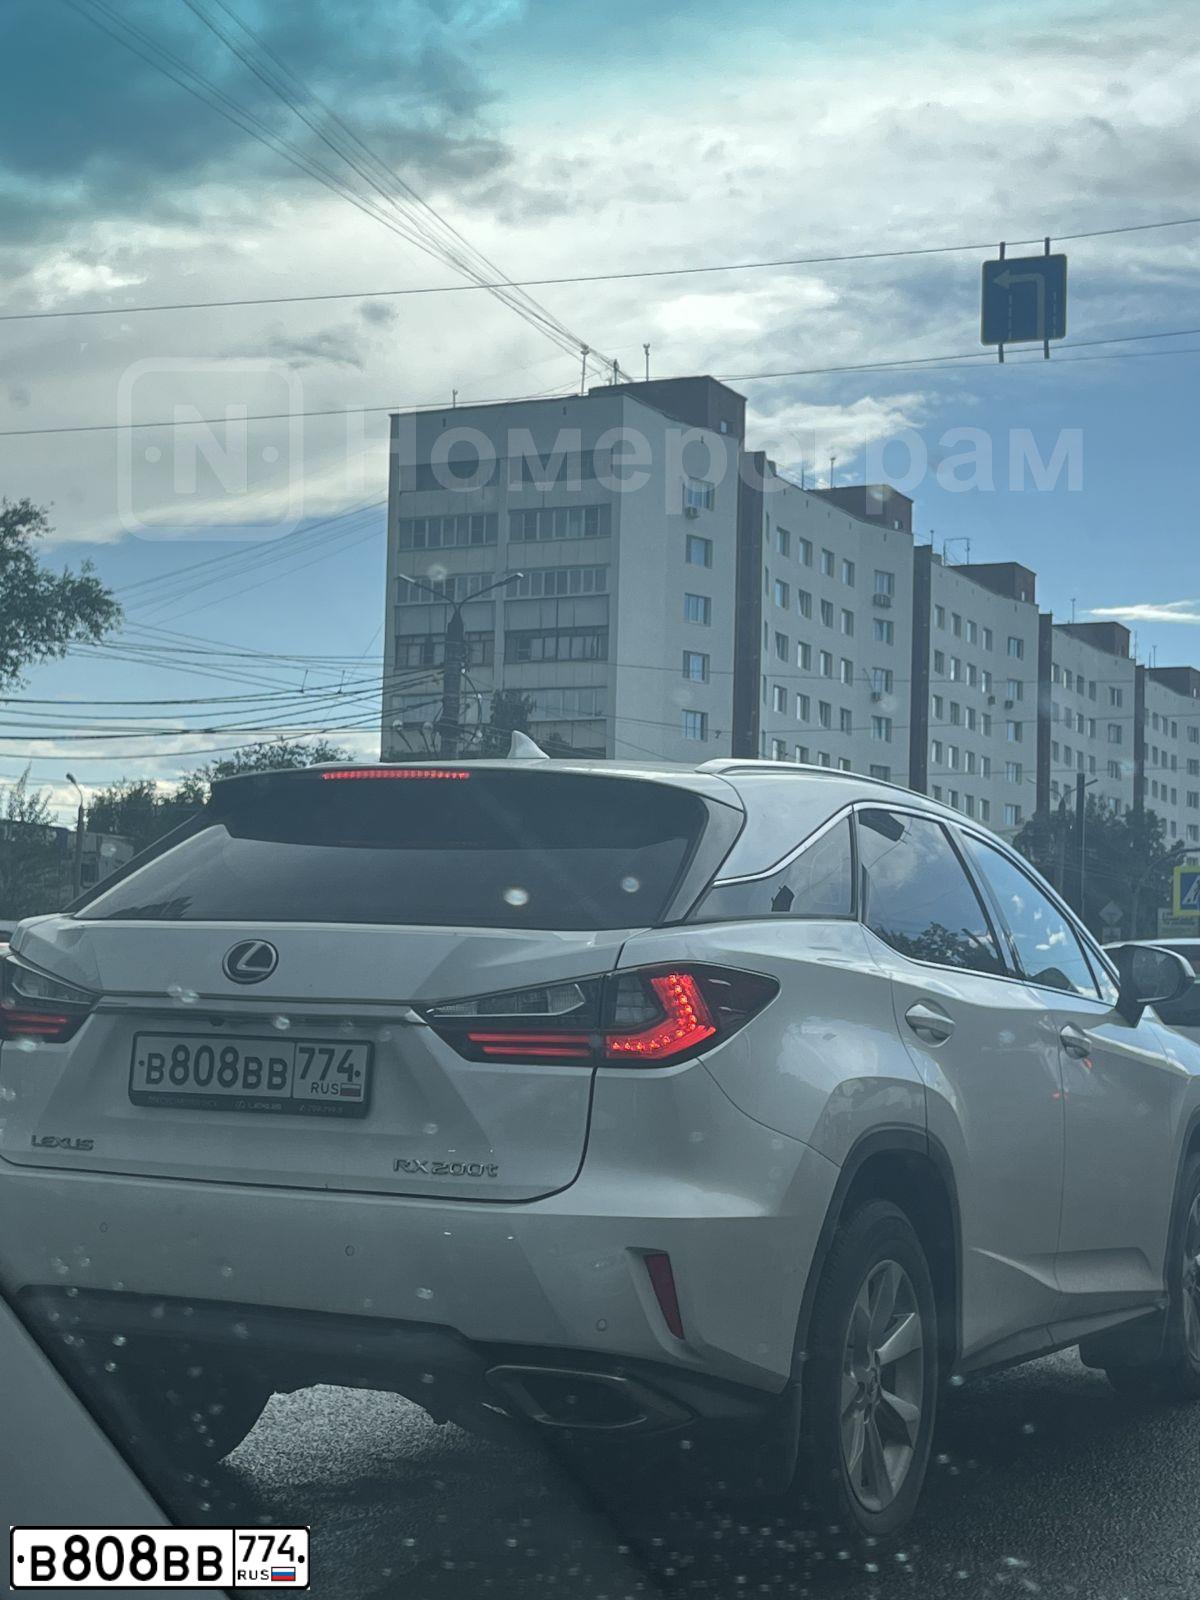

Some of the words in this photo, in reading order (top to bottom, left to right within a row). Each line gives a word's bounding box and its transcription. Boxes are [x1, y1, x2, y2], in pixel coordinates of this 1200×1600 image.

[298, 1047, 354, 1083] 774
[310, 1082, 339, 1096] RUS
[32, 1134, 95, 1152] LEXUS
